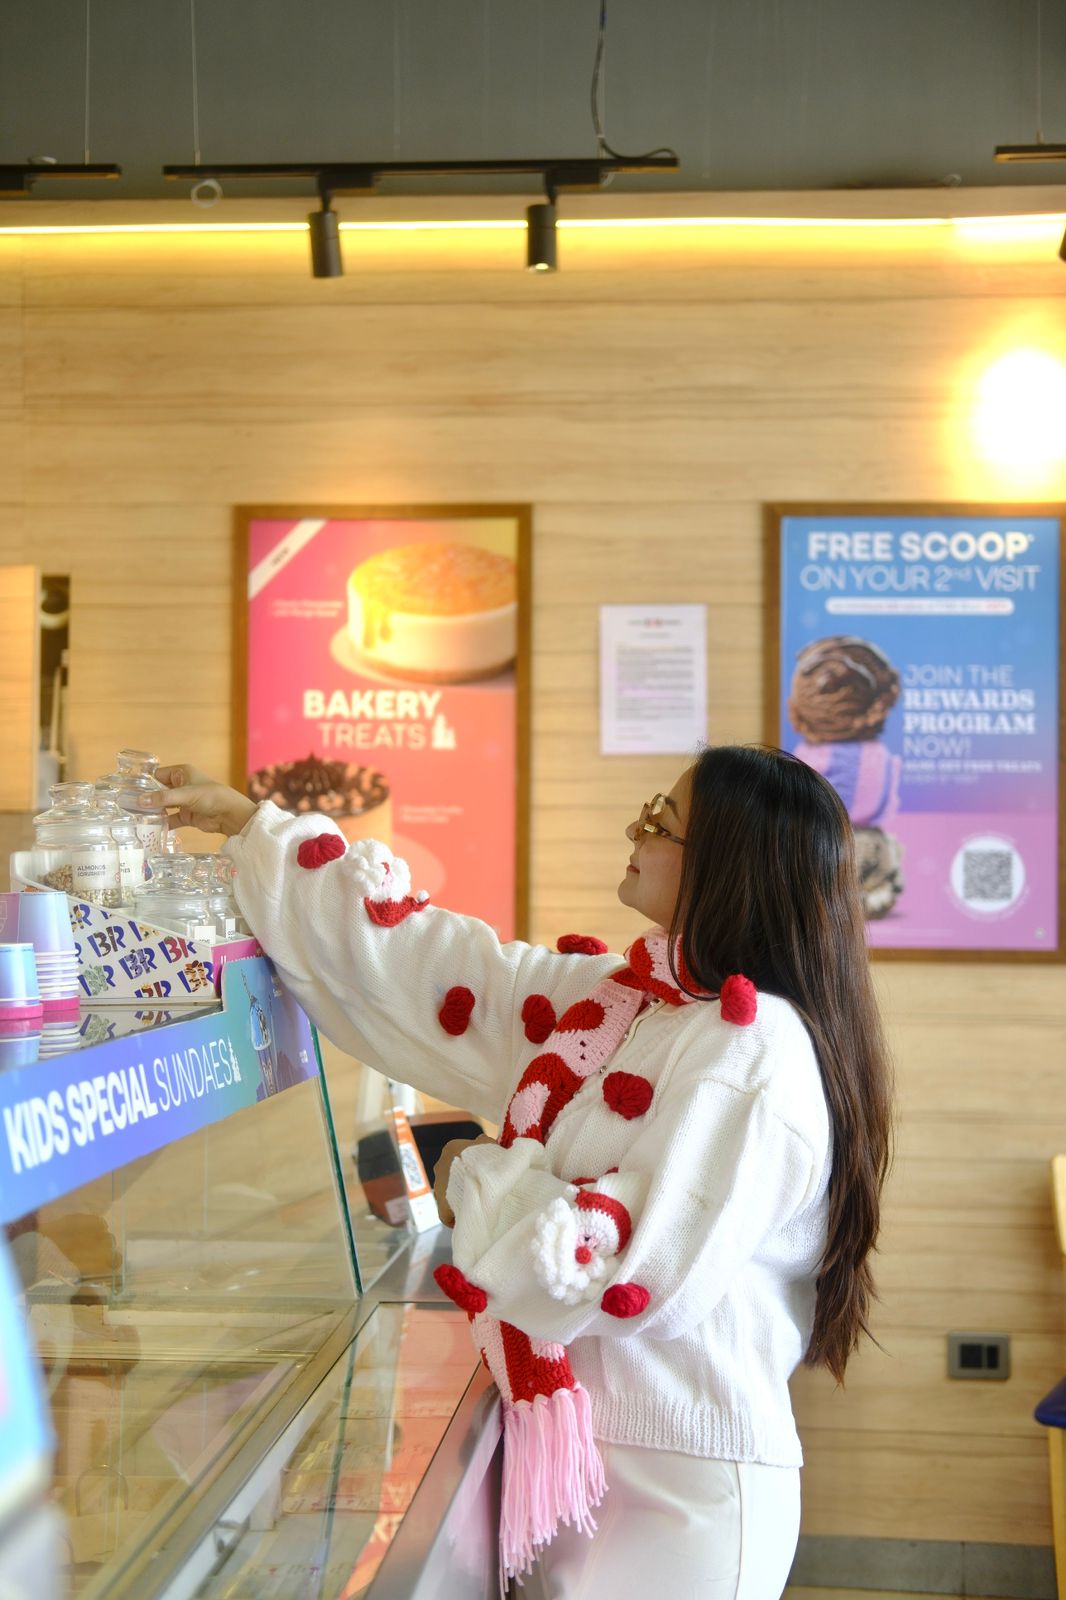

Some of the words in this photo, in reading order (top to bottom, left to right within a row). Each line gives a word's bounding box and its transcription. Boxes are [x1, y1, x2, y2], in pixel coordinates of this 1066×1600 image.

[808, 531, 894, 561] FREE
[800, 564, 846, 592] ON
[850, 564, 931, 592] YOUR
[934, 564, 972, 592] 2nd
[976, 564, 1041, 592] VISIT
[903, 664, 962, 687] JOIN
[967, 664, 1015, 687] THE
[303, 689, 443, 719] BAKERY
[903, 688, 1035, 710] REWARDS
[317, 722, 427, 749] TREATS
[903, 712, 1036, 735] PROGRAM
[903, 736, 972, 758] NOW!
[87, 925, 126, 957] BR
[119, 948, 157, 980] BR
[3, 1091, 71, 1175] KIDS
[66, 1063, 158, 1147] SPECIAL
[153, 1036, 233, 1112] SUNDAES
